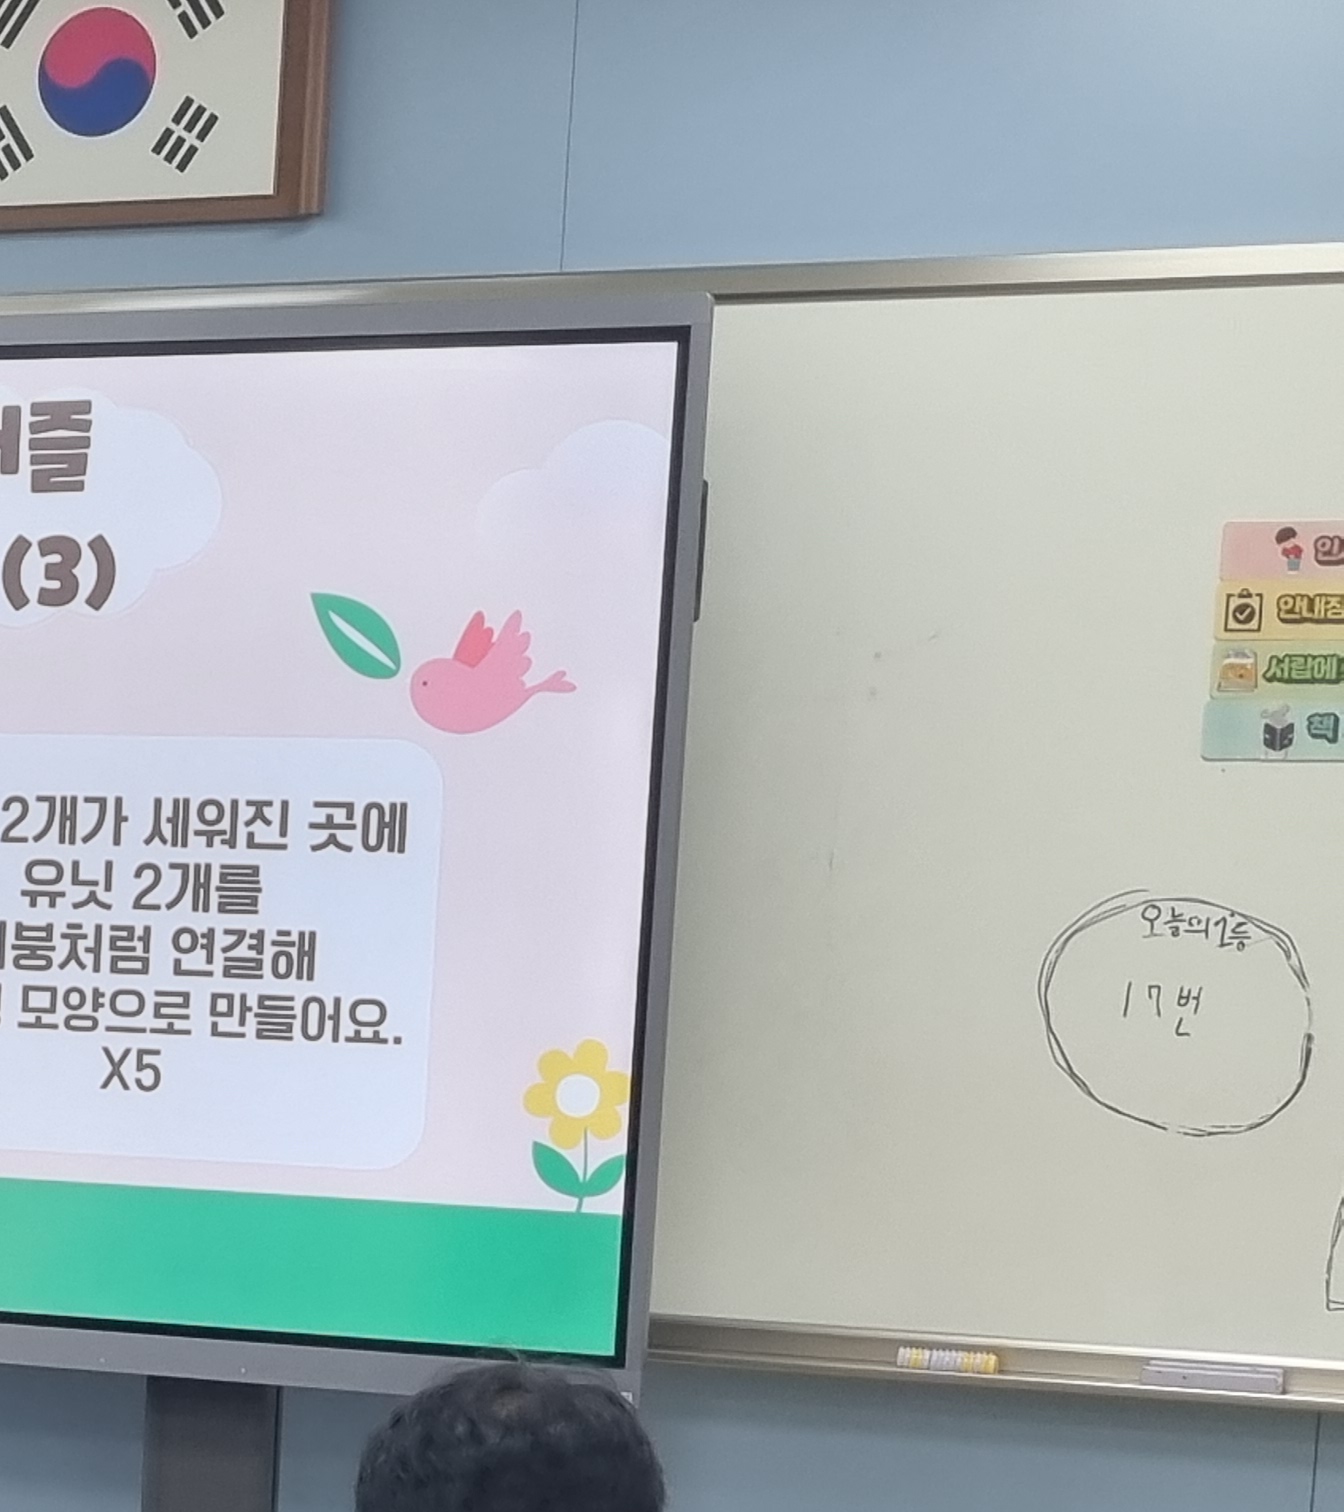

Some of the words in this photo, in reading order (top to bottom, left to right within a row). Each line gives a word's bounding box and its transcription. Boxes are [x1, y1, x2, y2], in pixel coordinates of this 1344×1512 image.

[2, 533, 115, 612] (3)
[1314, 535, 1344, 567] 인
[1264, 655, 1338, 683] 서랍에
[1307, 713, 1339, 743] 책
[0, 795, 129, 847] 2개가
[142, 797, 290, 851] 세워진
[307, 800, 408, 855] 곳에
[19, 857, 114, 911] 유닛
[131, 861, 263, 915] 2개를
[170, 926, 318, 982] 연결해
[16, 984, 193, 1037] 모양으로
[208, 991, 404, 1046] 만들어요.
[99, 1046, 163, 1092] X5
